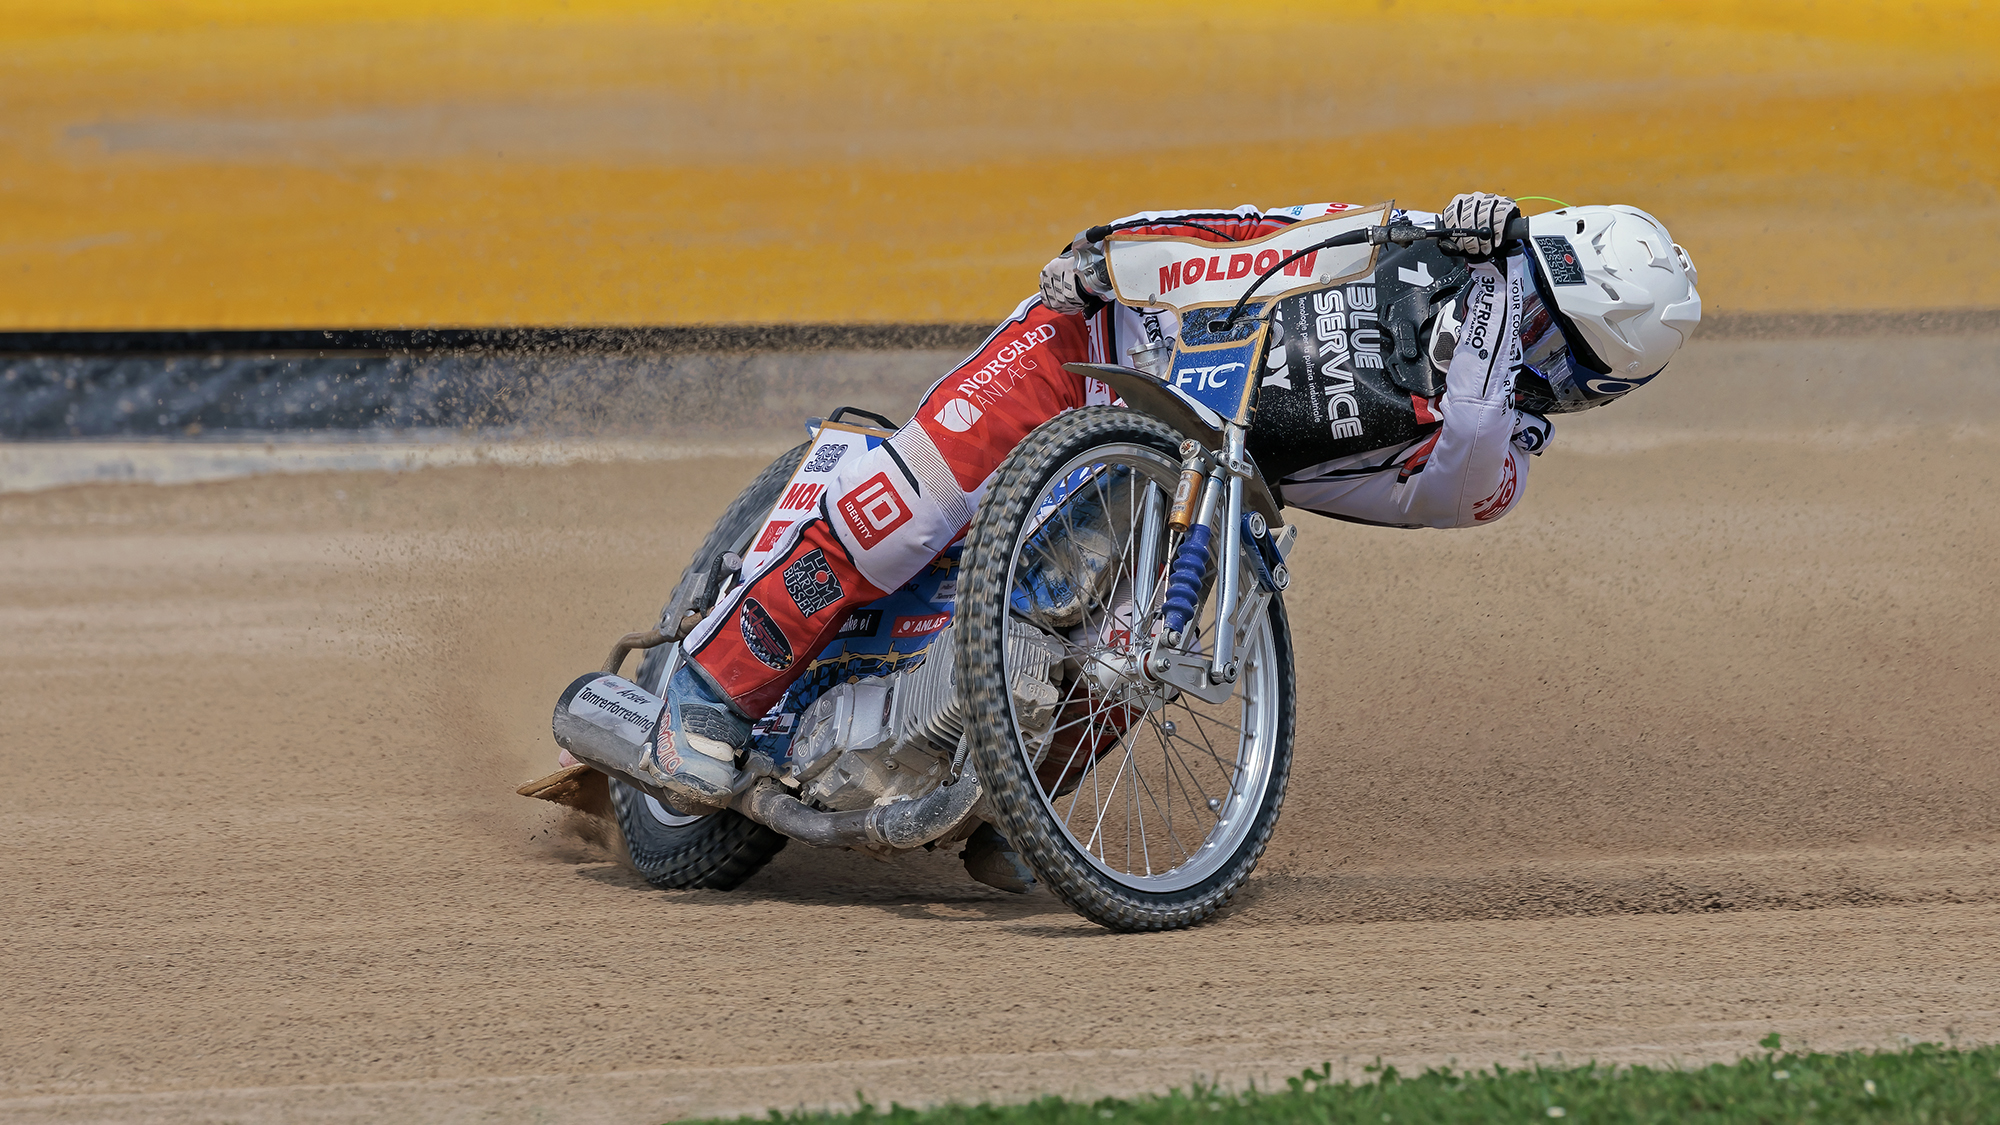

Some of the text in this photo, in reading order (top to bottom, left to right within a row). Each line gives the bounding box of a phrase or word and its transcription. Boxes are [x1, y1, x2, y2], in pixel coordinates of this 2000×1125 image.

[1158, 248, 1319, 296] MOLDOW
[1397, 261, 1435, 288] 1
[1537, 238, 1563, 283] BUSSER
[1544, 238, 1570, 283] GARDIN
[1297, 295, 1308, 331] Tecnologie
[1511, 278, 1521, 310] YOUR
[1346, 286, 1385, 370] BLUE
[1509, 313, 1521, 363] COOLEST
[975, 354, 1038, 411] ANLÆG
[1175, 361, 1246, 391] FTC
[1302, 354, 1316, 382] pulizia
[1312, 289, 1364, 440] SERVICE
[1307, 382, 1322, 424] industriale
[844, 501, 873, 539] IDENTITY
[855, 481, 901, 531] ID
[783, 565, 816, 618] BUSSER
[793, 560, 828, 611] GARDIN
[912, 616, 948, 633] ANLAS
